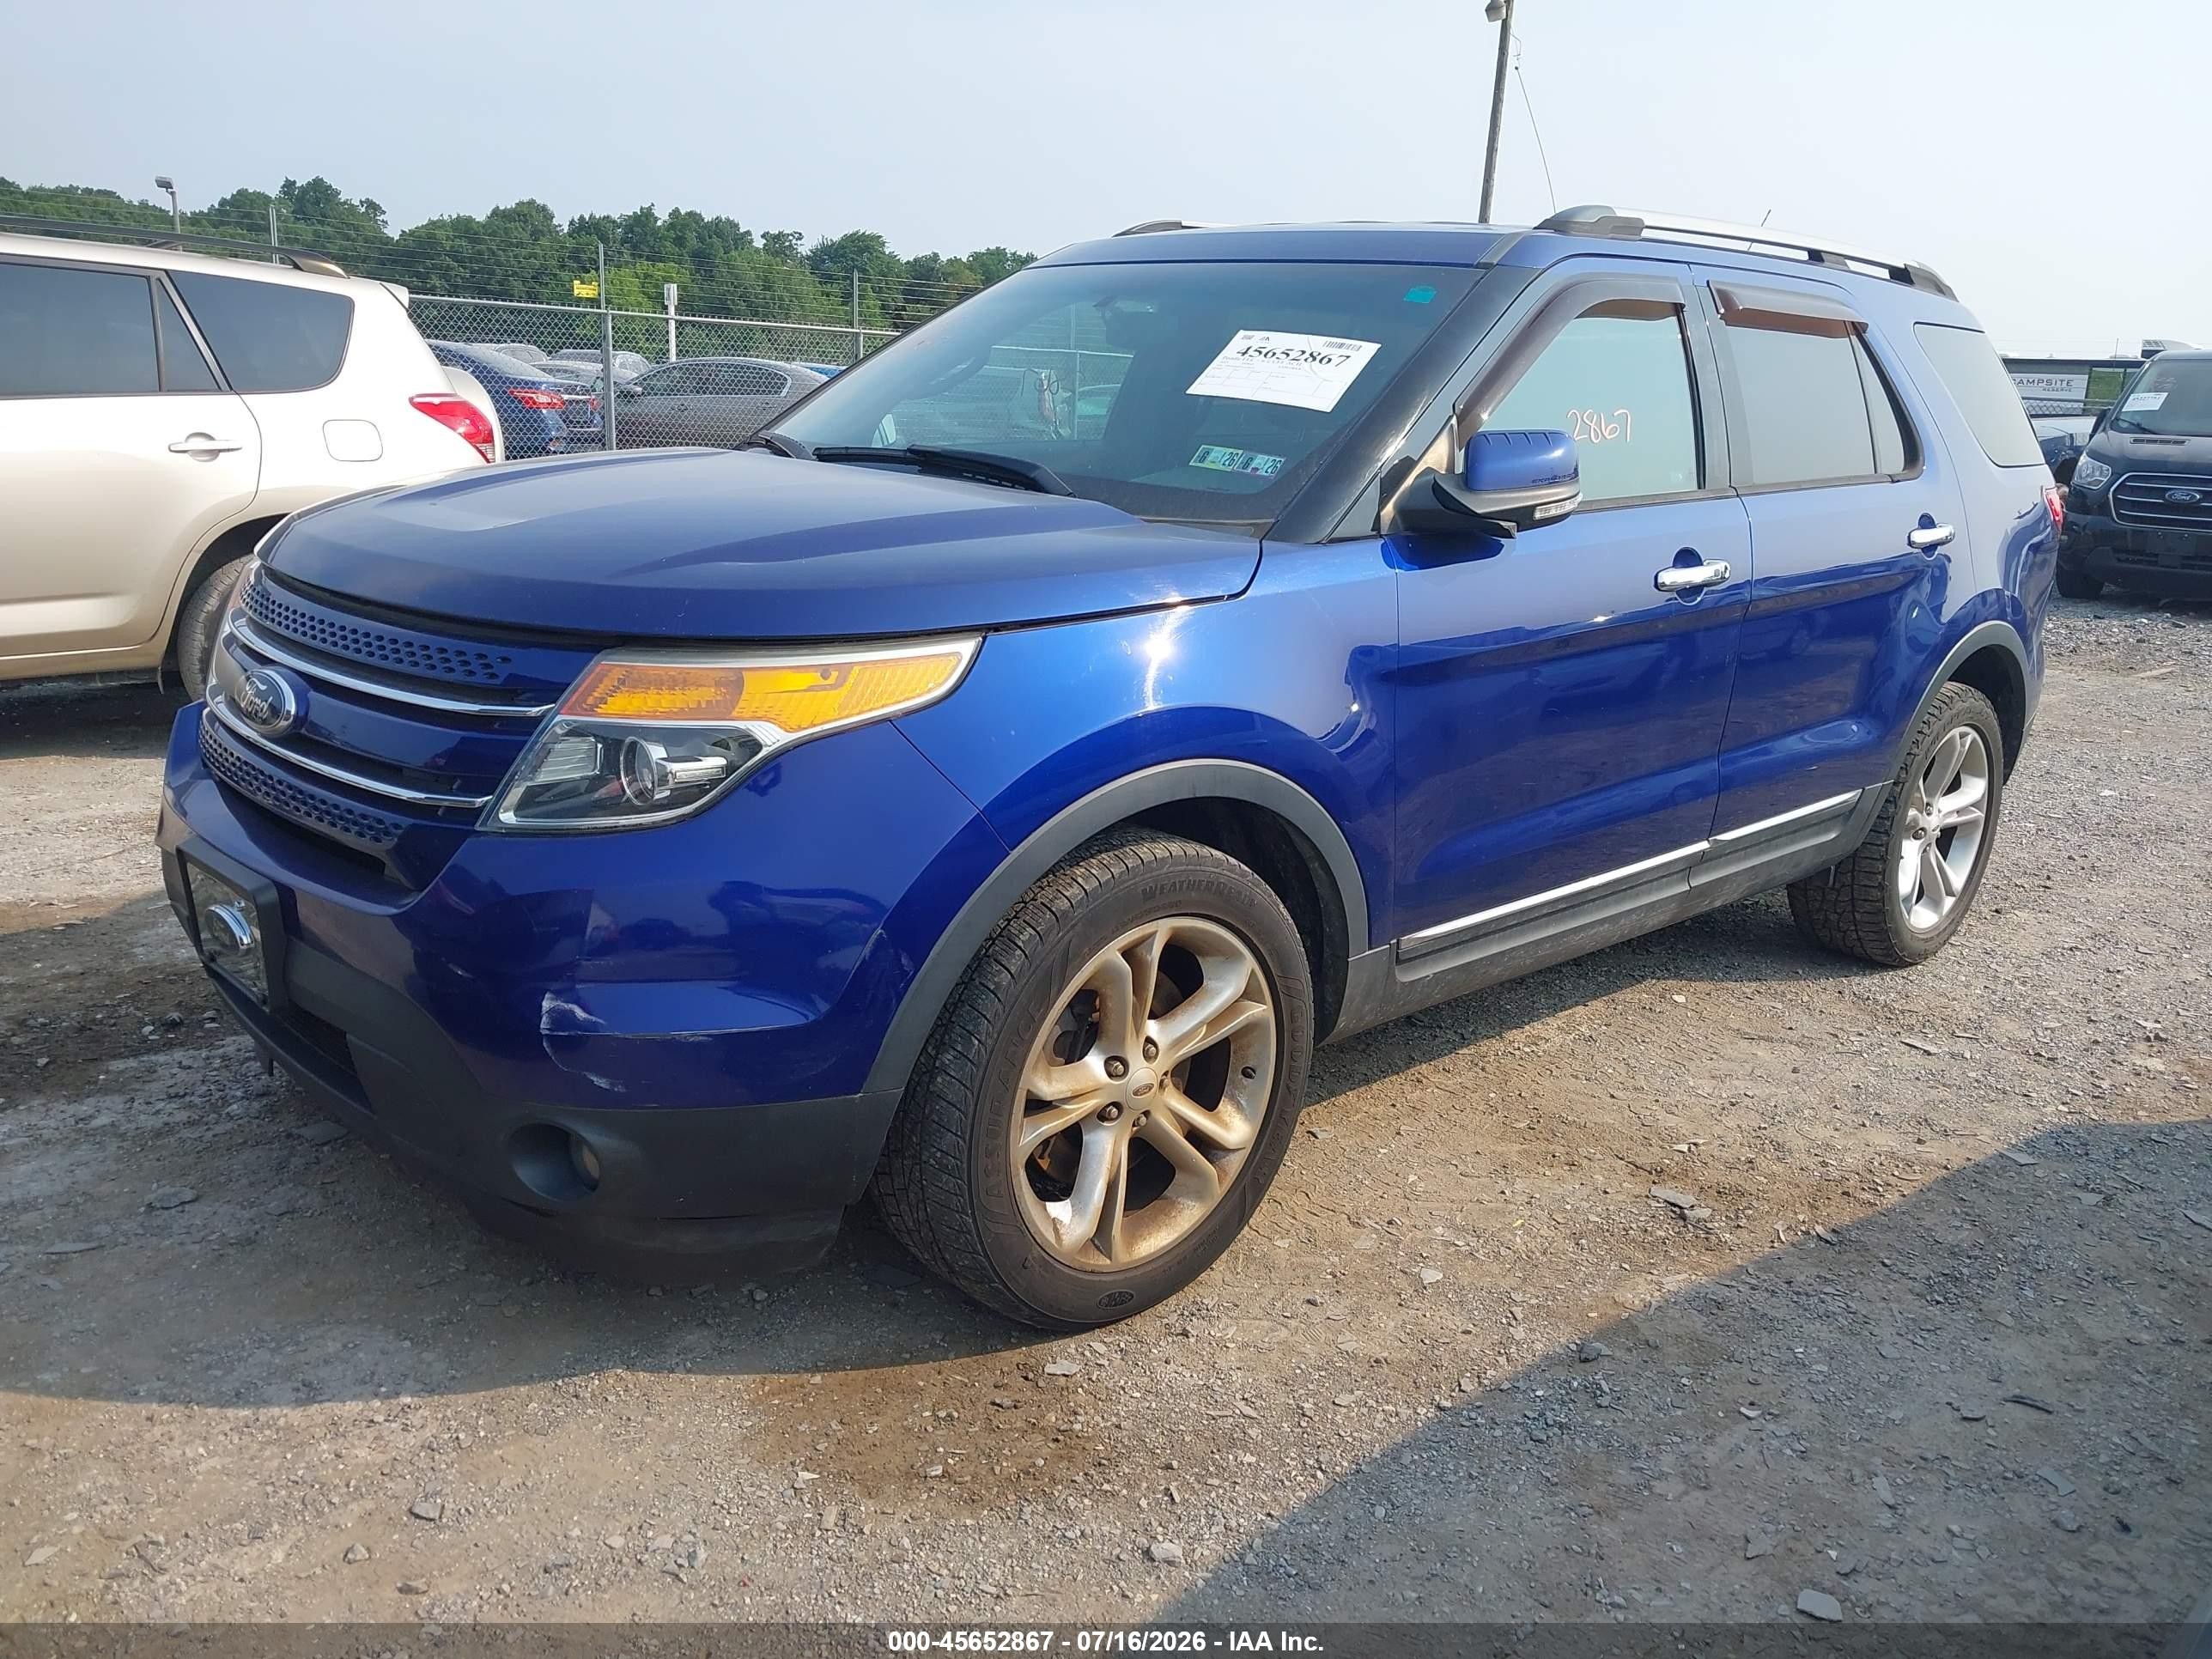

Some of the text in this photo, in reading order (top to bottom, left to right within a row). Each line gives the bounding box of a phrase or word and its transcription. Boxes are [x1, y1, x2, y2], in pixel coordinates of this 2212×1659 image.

[1237, 345, 1352, 368] 45652867
[1566, 408, 1632, 443] 2867
[240, 678, 273, 720] Ford
